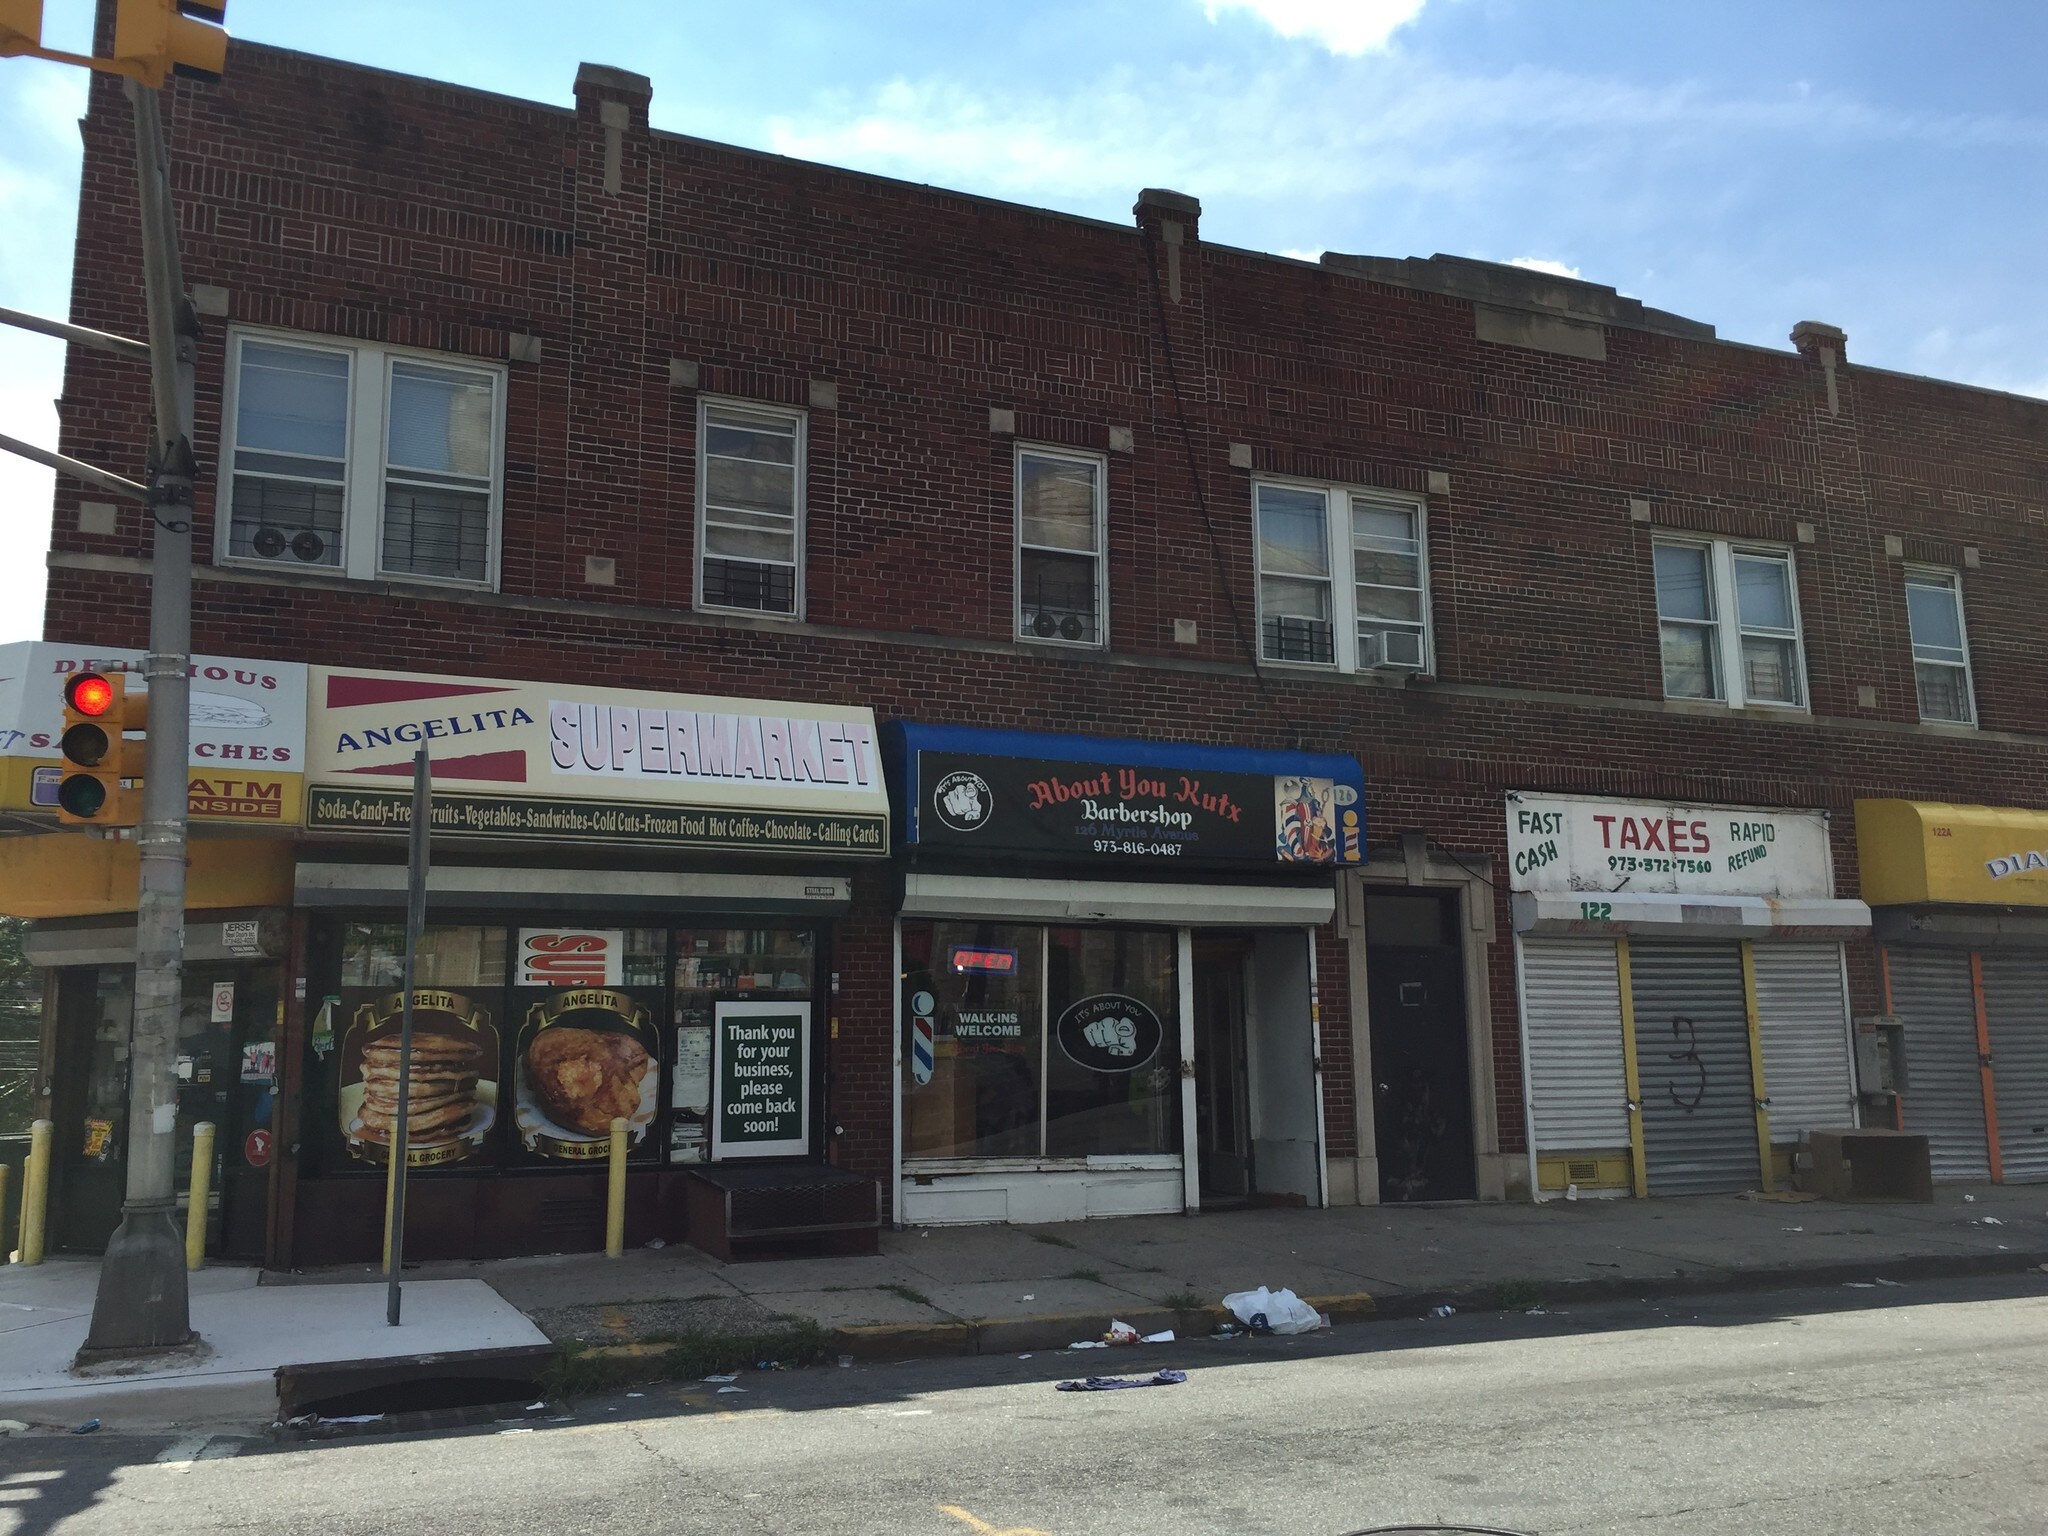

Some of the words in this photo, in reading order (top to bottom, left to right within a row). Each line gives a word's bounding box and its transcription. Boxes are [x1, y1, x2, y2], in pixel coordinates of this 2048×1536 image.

[336, 706, 535, 754] ANGELITA
[550, 702, 870, 785] SUPERMARKET
[188, 778, 282, 799] ATM
[1027, 771, 1110, 809] About
[1118, 769, 1166, 800] You
[1173, 776, 1241, 823] Kutx
[188, 800, 279, 815] NSIDE
[1081, 799, 1193, 830] Barbershop
[680, 815, 706, 836] Food
[709, 817, 728, 838] Hot
[853, 824, 879, 844] Cards
[1074, 823, 1098, 836] 126
[1101, 823, 1147, 840] Myrtle
[1152, 826, 1200, 841] Avenue
[1518, 811, 1563, 835] FAST
[1729, 821, 1776, 842] RAPID
[1932, 827, 1952, 837] 122A
[1593, 815, 1711, 854] TAXES
[1093, 840, 1183, 856] 973-816-0487
[1514, 839, 1559, 876] CASH
[1727, 844, 1768, 873] REFUND
[1580, 901, 1611, 920] 122
[224, 922, 256, 933] JERSEY
[394, 994, 455, 1009] AGELITA
[562, 993, 618, 1008] ANGELITA
[959, 1012, 1018, 1024] WALK-INS
[1074, 1007, 1090, 1025] IT'S
[1093, 1001, 1121, 1014] ABOUT
[1124, 1004, 1142, 1017] YOU
[728, 1024, 770, 1041] Thank
[771, 1028, 796, 1043] you
[955, 1025, 1021, 1037] WELCOME
[737, 1043, 758, 1059] for
[760, 1045, 791, 1062] your
[734, 1061, 794, 1079] business,
[740, 1079, 783, 1100] please
[727, 1101, 763, 1115] come
[765, 1097, 797, 1113] back
[743, 1116, 779, 1133] soon!
[419, 1147, 457, 1163] GROCERY
